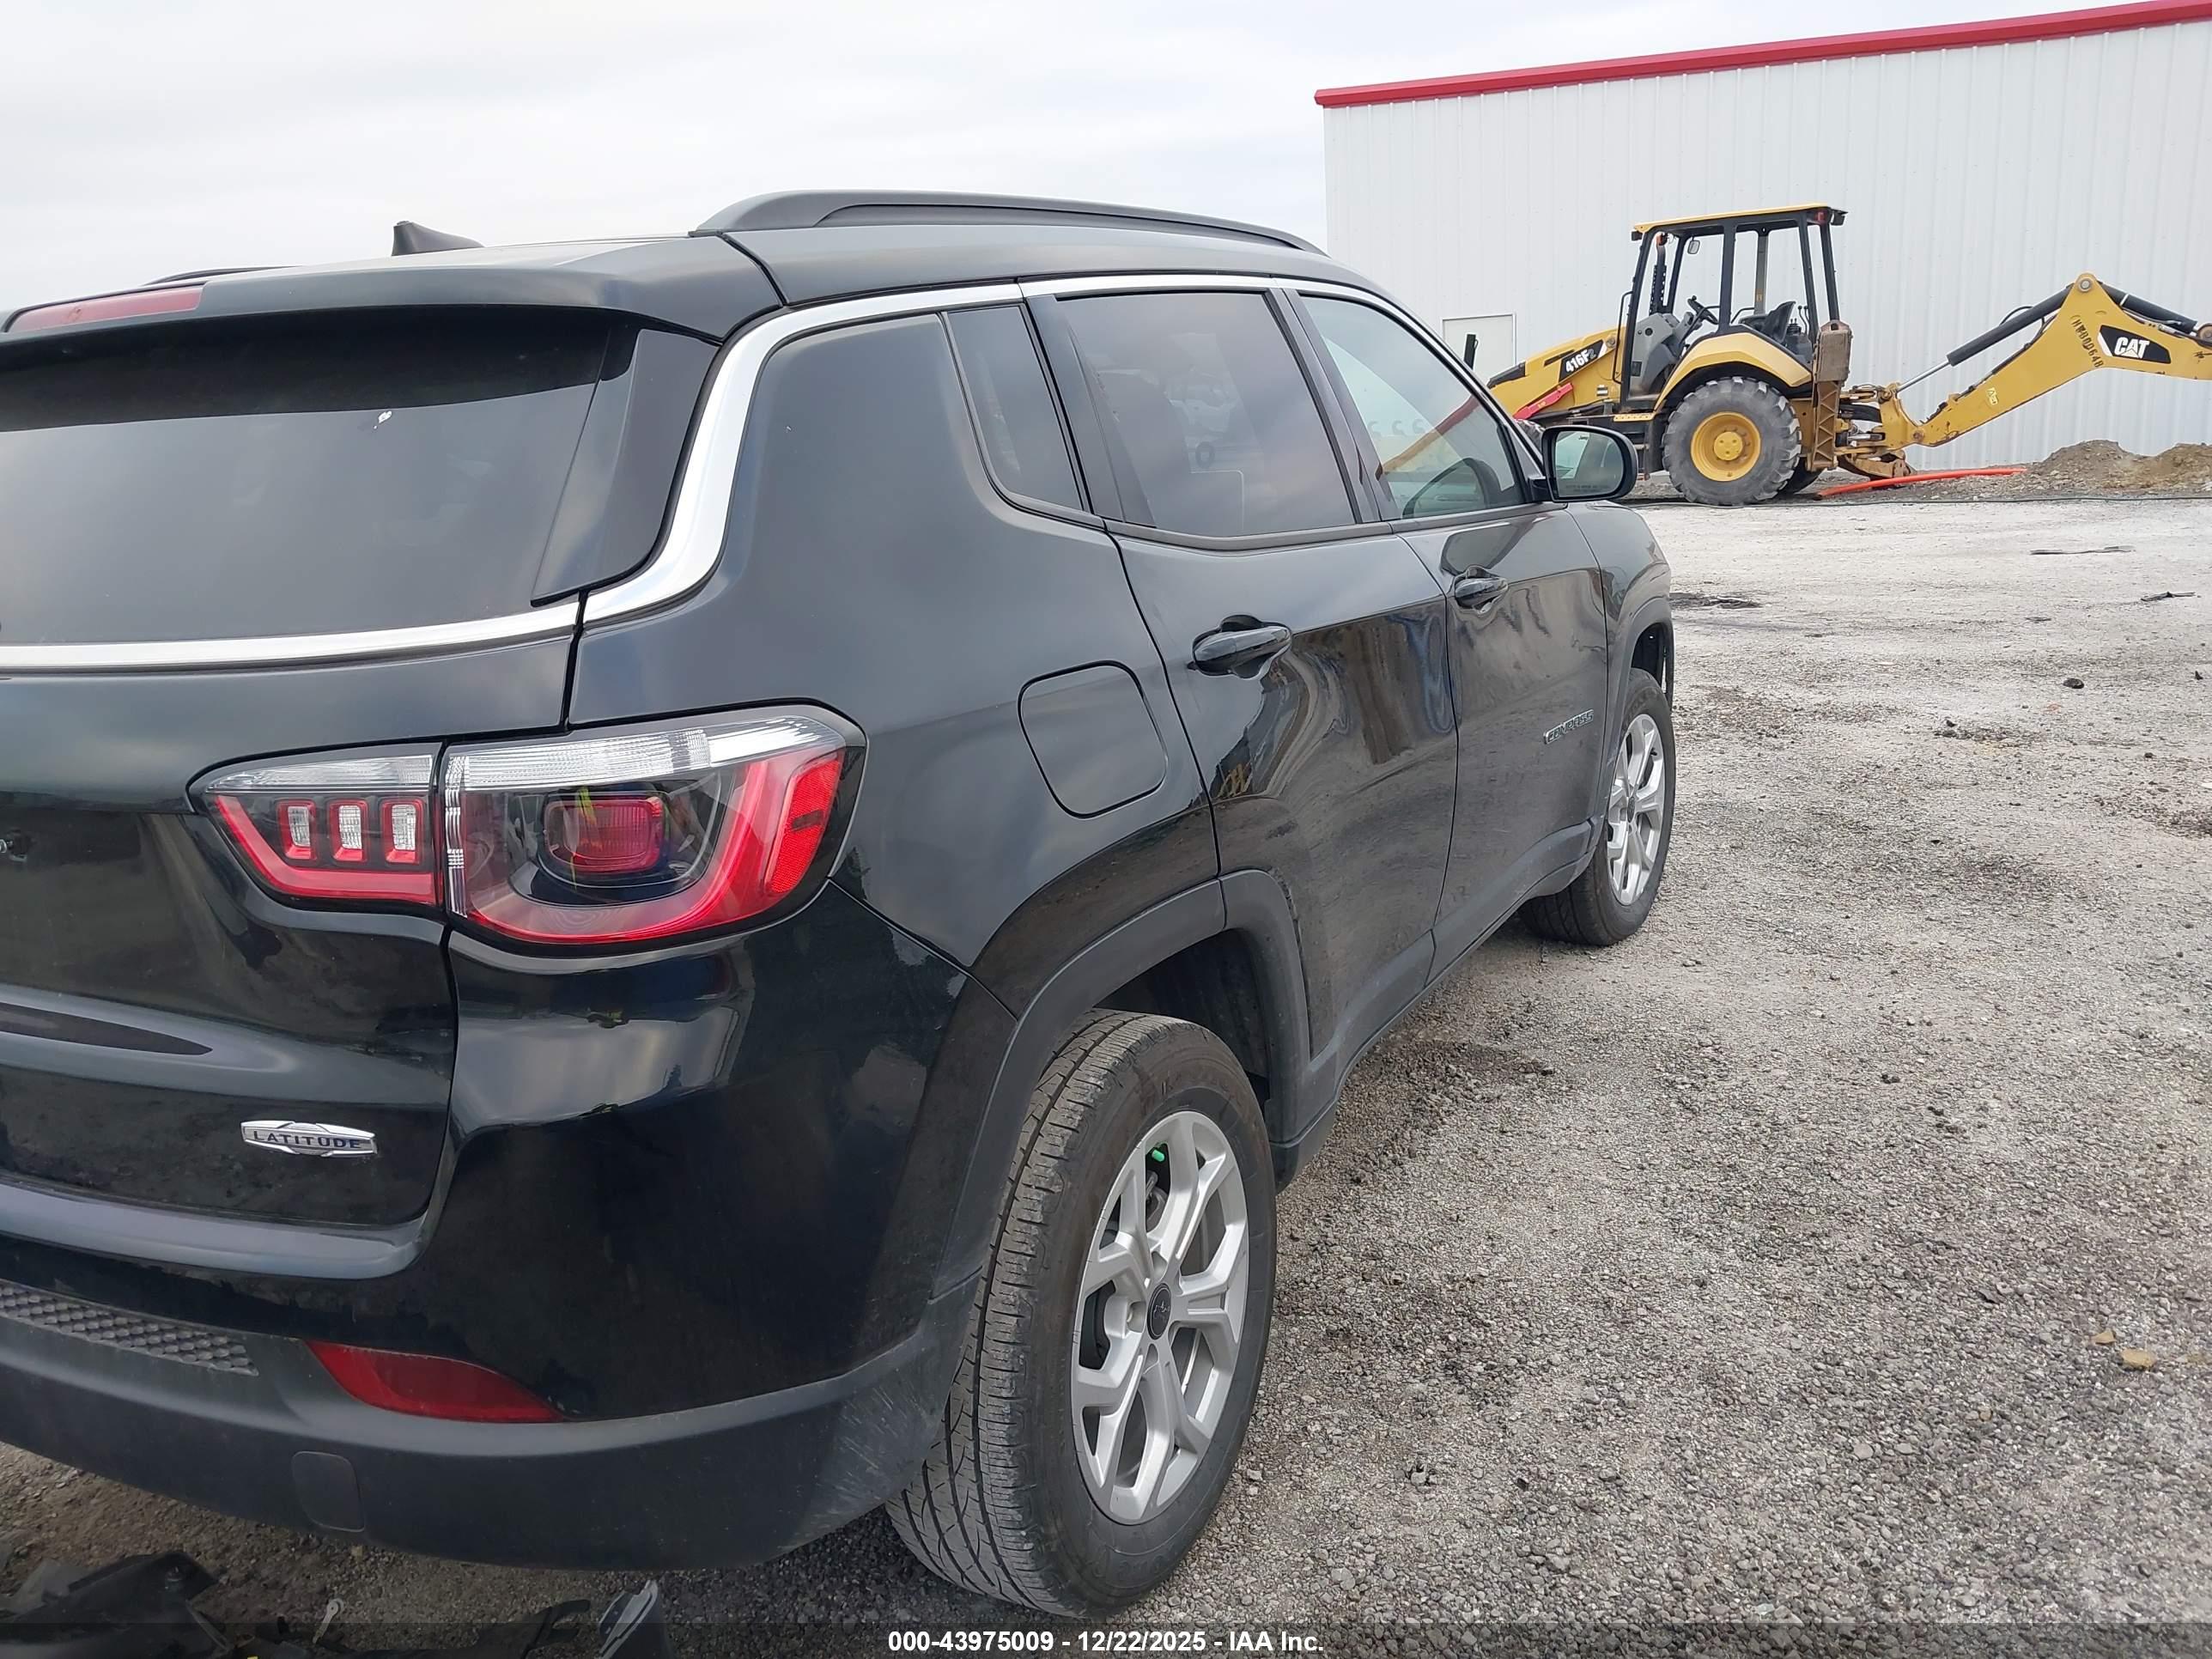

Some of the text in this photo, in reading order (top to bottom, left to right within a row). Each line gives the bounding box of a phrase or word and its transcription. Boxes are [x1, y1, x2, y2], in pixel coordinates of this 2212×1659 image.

[2114, 337, 2150, 359] CAT
[1545, 709, 1595, 744] COMPASS
[253, 1130, 362, 1149] LATITUDE
